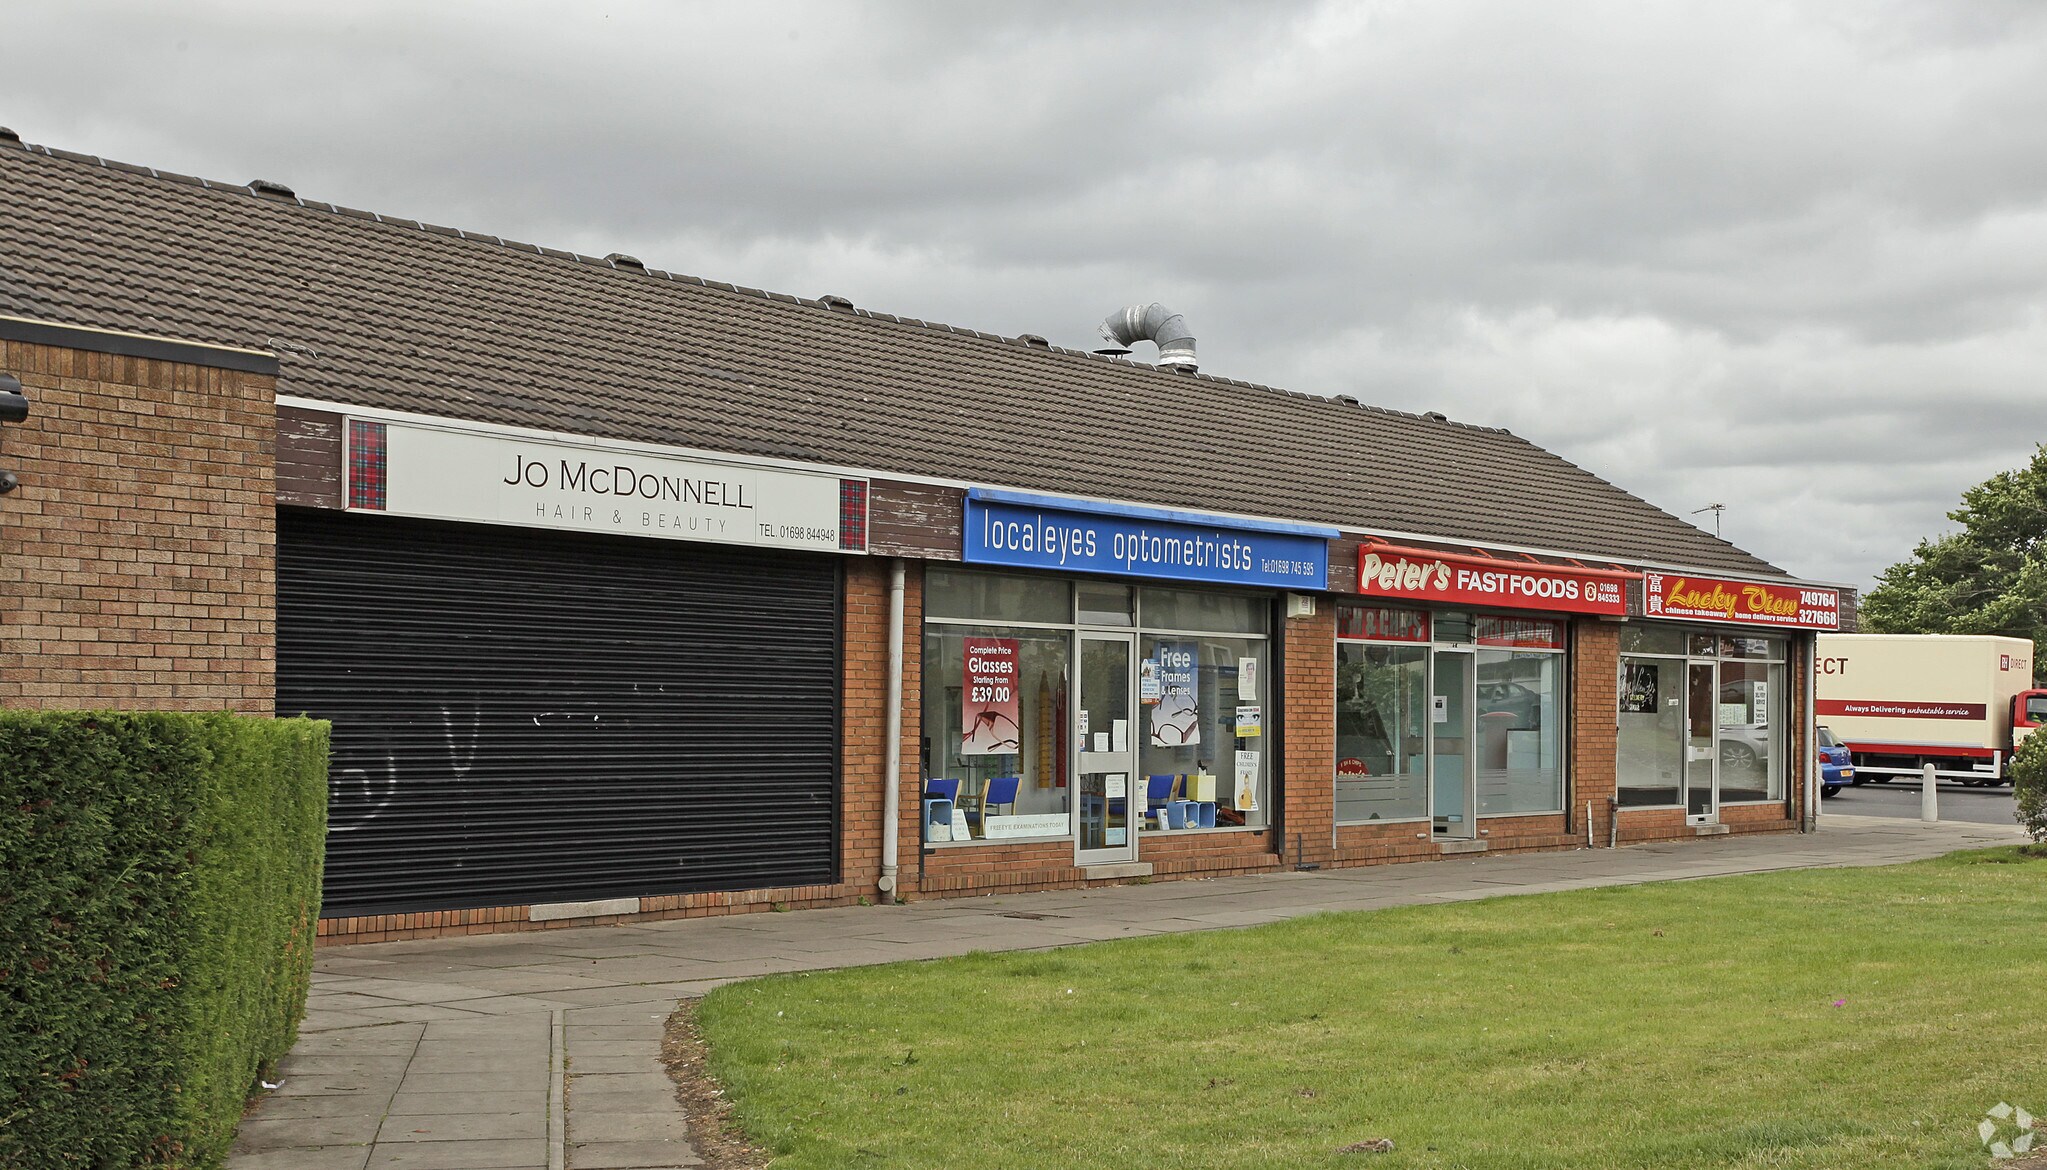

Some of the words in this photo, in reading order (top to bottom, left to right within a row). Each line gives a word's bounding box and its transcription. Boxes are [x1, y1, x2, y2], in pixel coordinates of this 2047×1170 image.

[536, 503, 593, 521] HAIR
[612, 509, 622, 524] &
[642, 512, 727, 533] BEAUTY
[759, 523, 778, 537] TEL.
[780, 525, 805, 540] 01698
[806, 527, 835, 542] 844948
[984, 508, 1097, 565] localeyes
[1113, 529, 1252, 571] optometrists
[1291, 560, 1302, 575] 745
[1303, 561, 1314, 576] 595
[1361, 553, 1452, 591] Peter's
[1599, 582, 1619, 593] 01698
[1597, 591, 1620, 604] 845333
[1665, 578, 1738, 619] Lucky
[1742, 584, 1798, 616] View
[1799, 591, 1836, 608] 749764
[1665, 606, 1694, 616] chinese
[1694, 608, 1727, 619] takeaway
[1734, 611, 1752, 620] home
[1752, 613, 1776, 622] delivery
[1776, 615, 1798, 624] service
[1799, 609, 1837, 626] 327668
[970, 645, 998, 656] Complete
[997, 646, 1012, 655] Price
[1161, 647, 1191, 668] Free
[968, 657, 1013, 674] Glasses
[2010, 657, 2027, 670] DIRECT
[973, 675, 994, 686] Starting
[994, 676, 1009, 684] From
[1161, 670, 1191, 682] Frames
[971, 686, 1010, 703] £39.00
[1161, 685, 1166, 695] &
[1845, 704, 1869, 714] Always
[1870, 705, 1906, 715] Delivering
[1907, 706, 1945, 716] unbeatable
[1945, 707, 1970, 716] service
[1240, 752, 1253, 760] FREE
